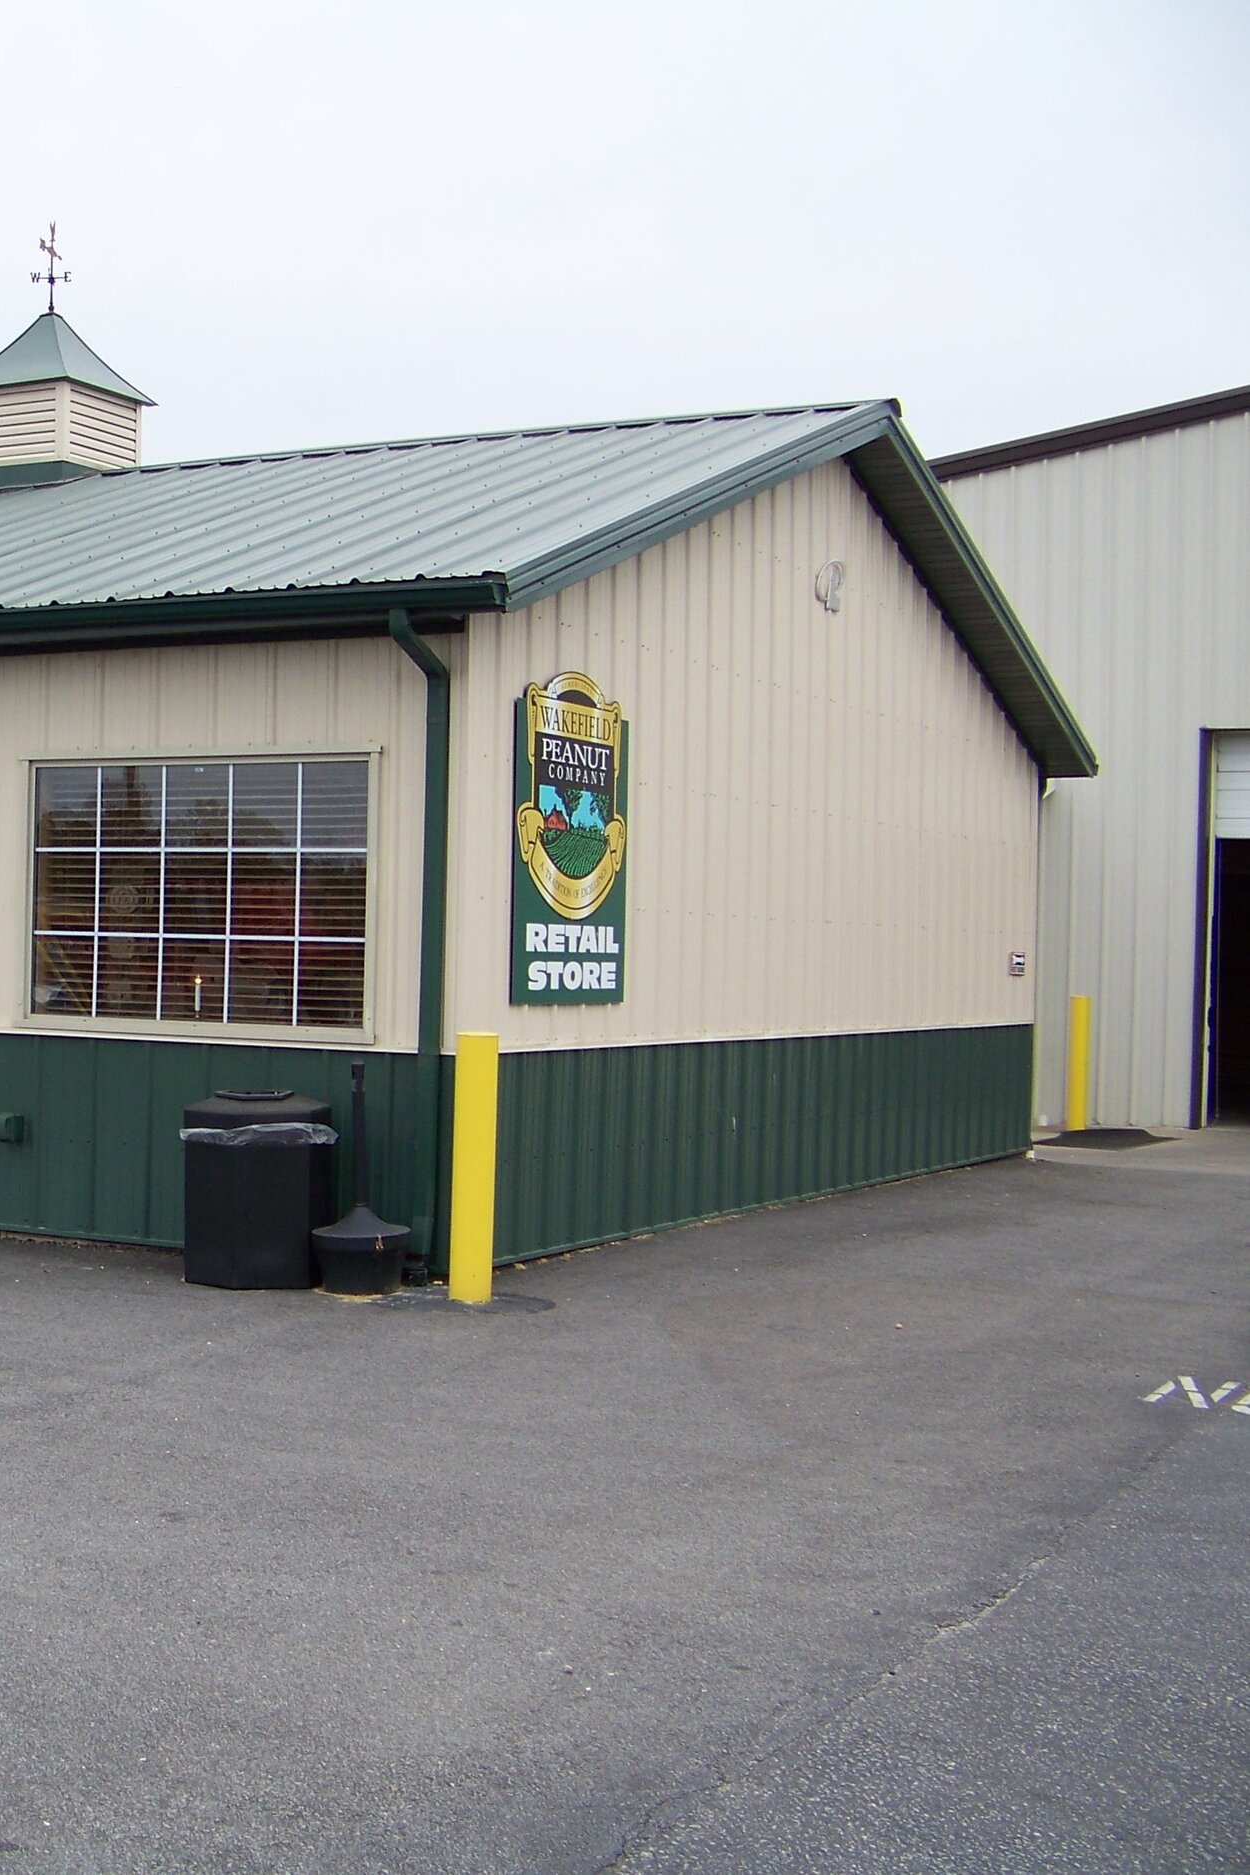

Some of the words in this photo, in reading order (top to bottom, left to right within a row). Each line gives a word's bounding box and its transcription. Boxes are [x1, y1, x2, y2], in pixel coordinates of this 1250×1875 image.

[540, 704, 611, 741] WAKEFIELD
[541, 738, 609, 771] PEANUT
[548, 763, 606, 786] COMPANY
[525, 923, 619, 954] RETAIL
[528, 960, 617, 991] STORE
